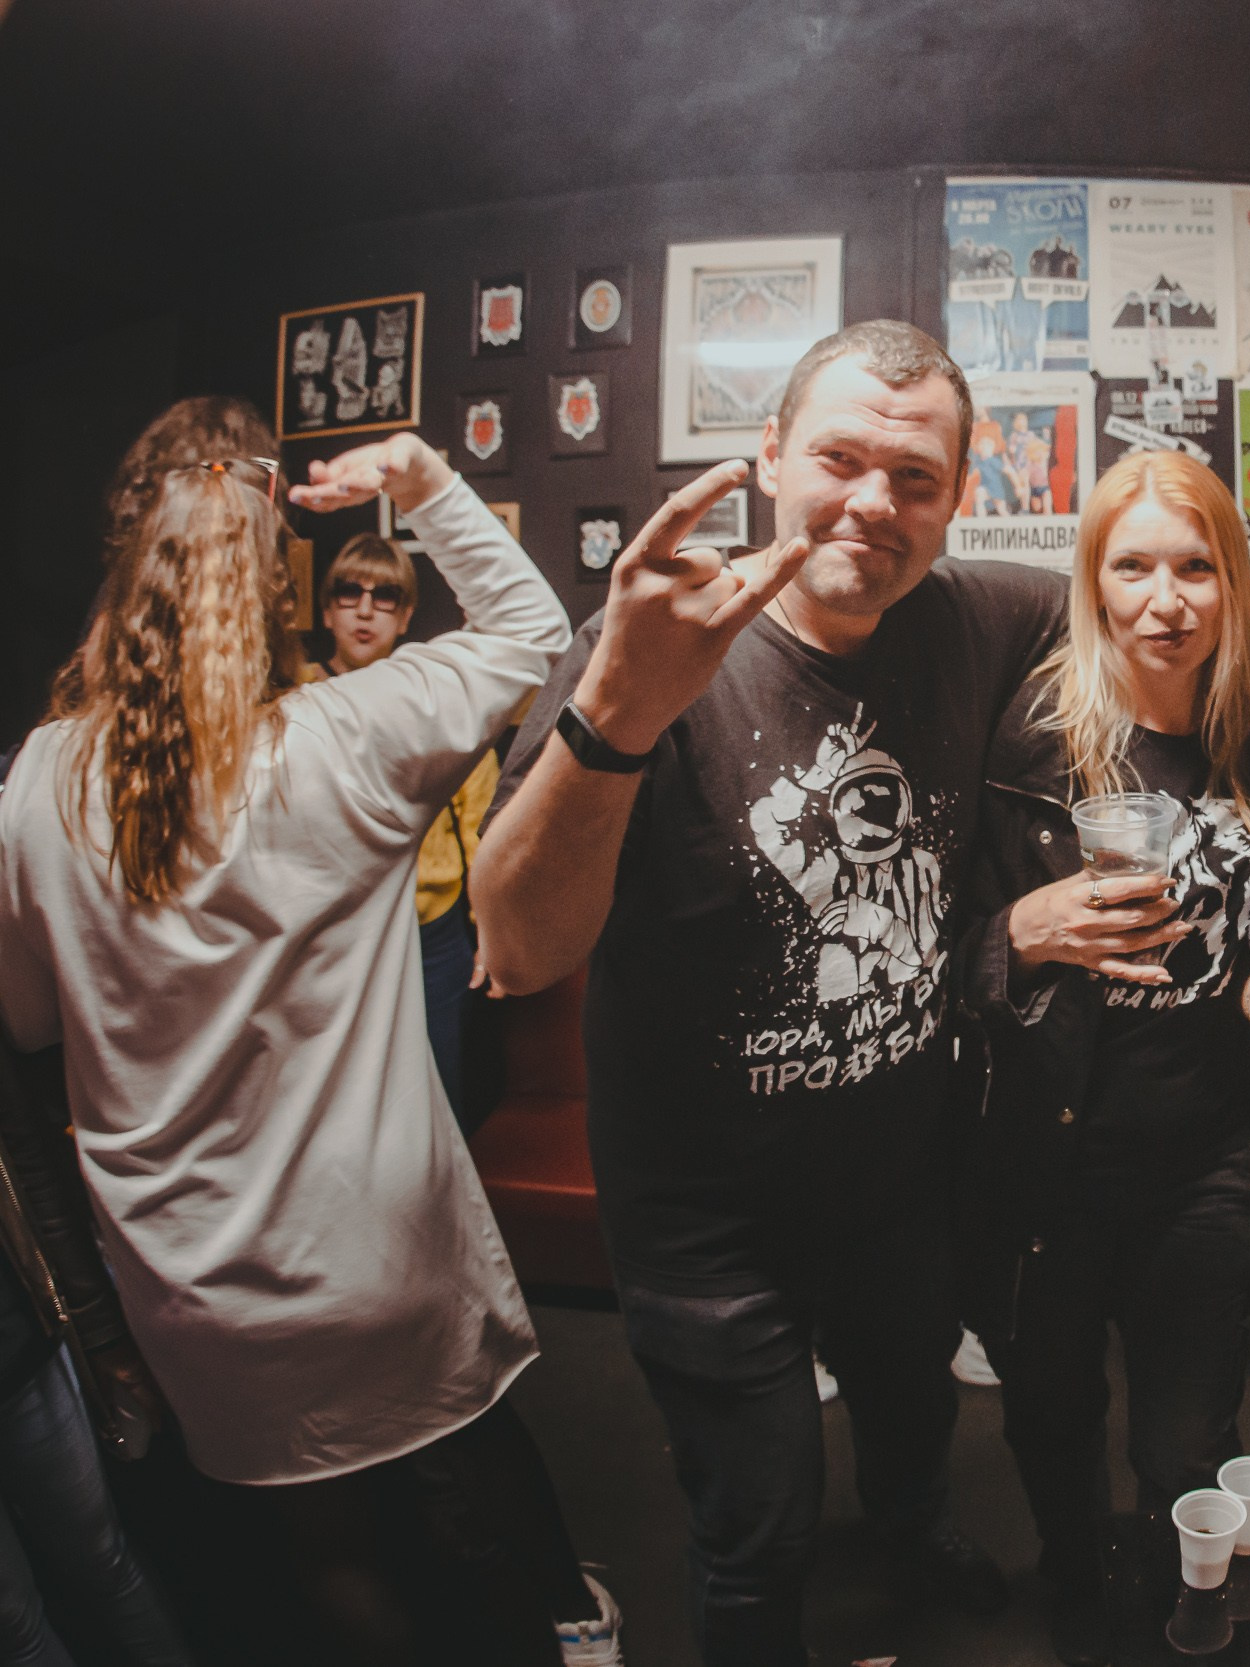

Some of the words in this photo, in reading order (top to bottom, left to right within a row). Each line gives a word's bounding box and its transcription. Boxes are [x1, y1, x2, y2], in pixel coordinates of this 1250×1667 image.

[1109, 223, 1169, 235] WEARY
[1174, 223, 1216, 235] EYES
[740, 1019, 833, 1057] ЮРА,
[844, 982, 905, 1041] МЫ
